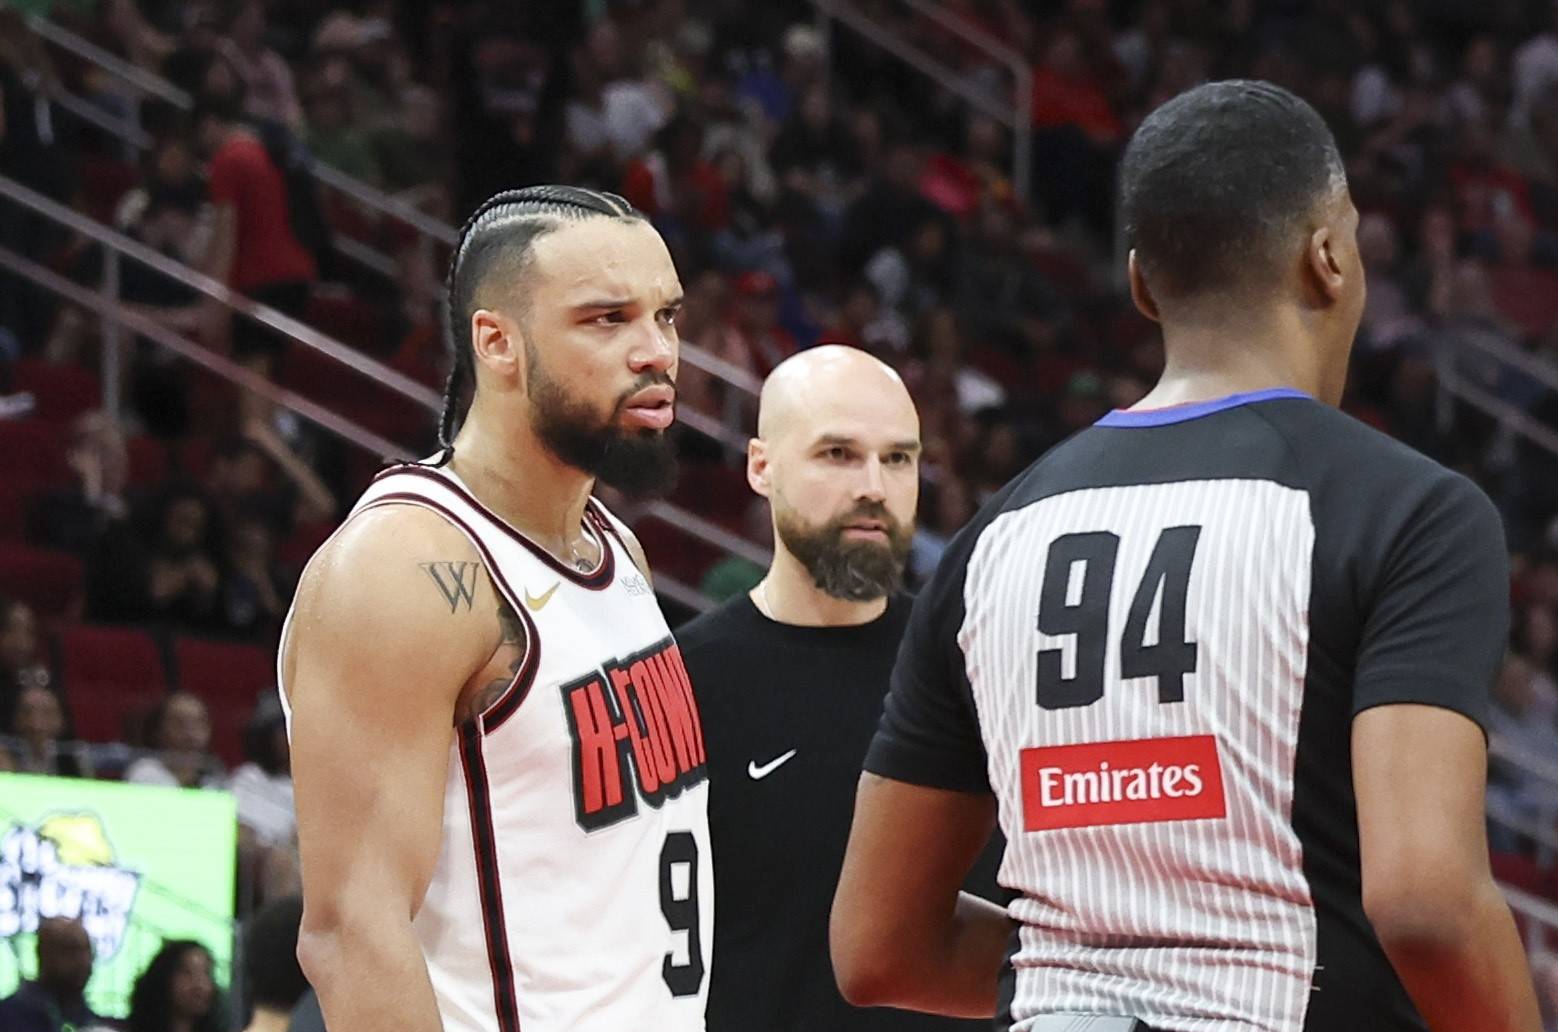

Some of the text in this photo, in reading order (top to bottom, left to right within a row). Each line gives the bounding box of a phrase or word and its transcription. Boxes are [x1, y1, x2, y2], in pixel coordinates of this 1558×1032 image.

[418, 561, 480, 614] W
[1036, 525, 1202, 710] 94
[1038, 762, 1202, 807] Emirates
[659, 831, 705, 996] 9
